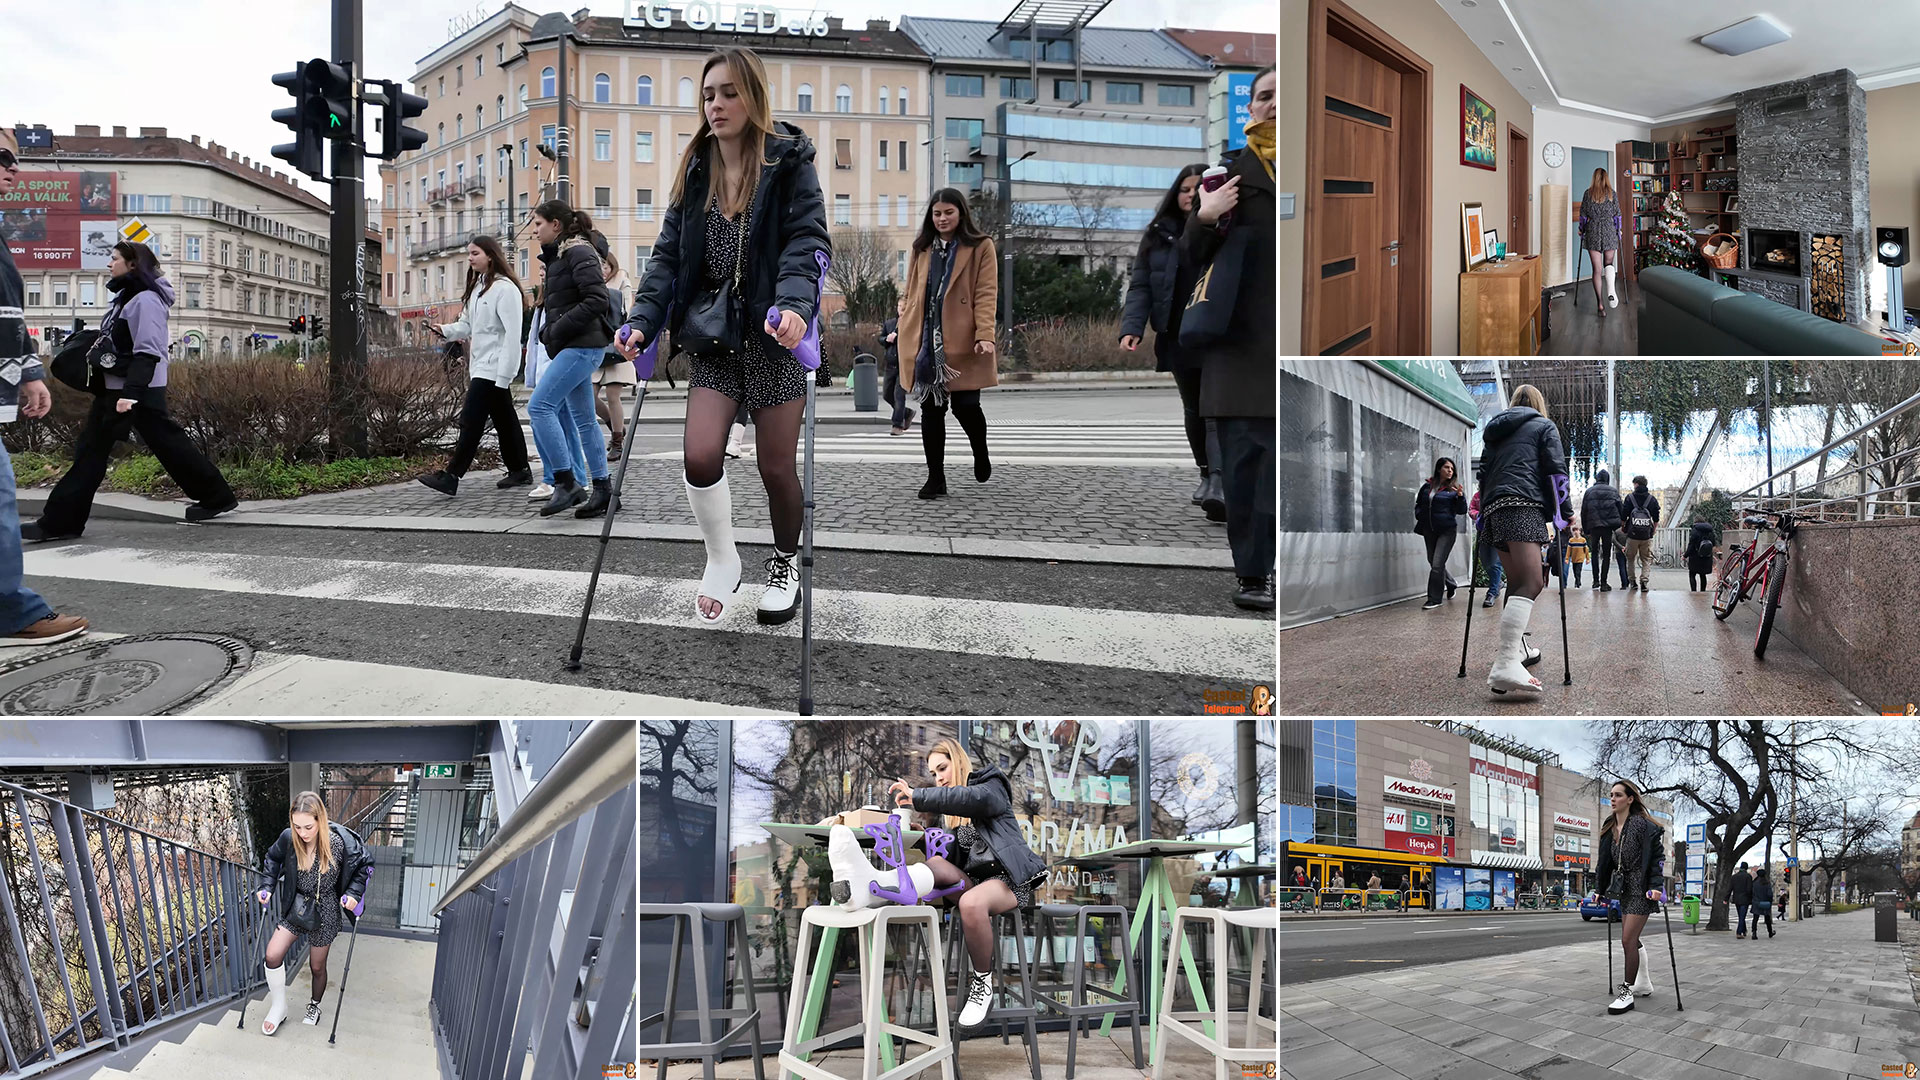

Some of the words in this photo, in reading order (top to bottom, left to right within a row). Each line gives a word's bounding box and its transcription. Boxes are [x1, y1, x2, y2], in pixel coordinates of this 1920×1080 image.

[623, 0, 672, 28] LG
[685, 0, 782, 34] OLED
[787, 19, 829, 37] evo
[17, 181, 27, 190] A
[29, 180, 70, 190] SPORT
[34, 190, 73, 202] VÁLIK.
[1632, 517, 1651, 526] VANS
[1475, 763, 1529, 787] Mammut
[1386, 812, 1404, 825] H&M
[1416, 815, 1428, 827] D
[1409, 838, 1435, 854] Hervis
[1555, 854, 1577, 863] CINEMA
